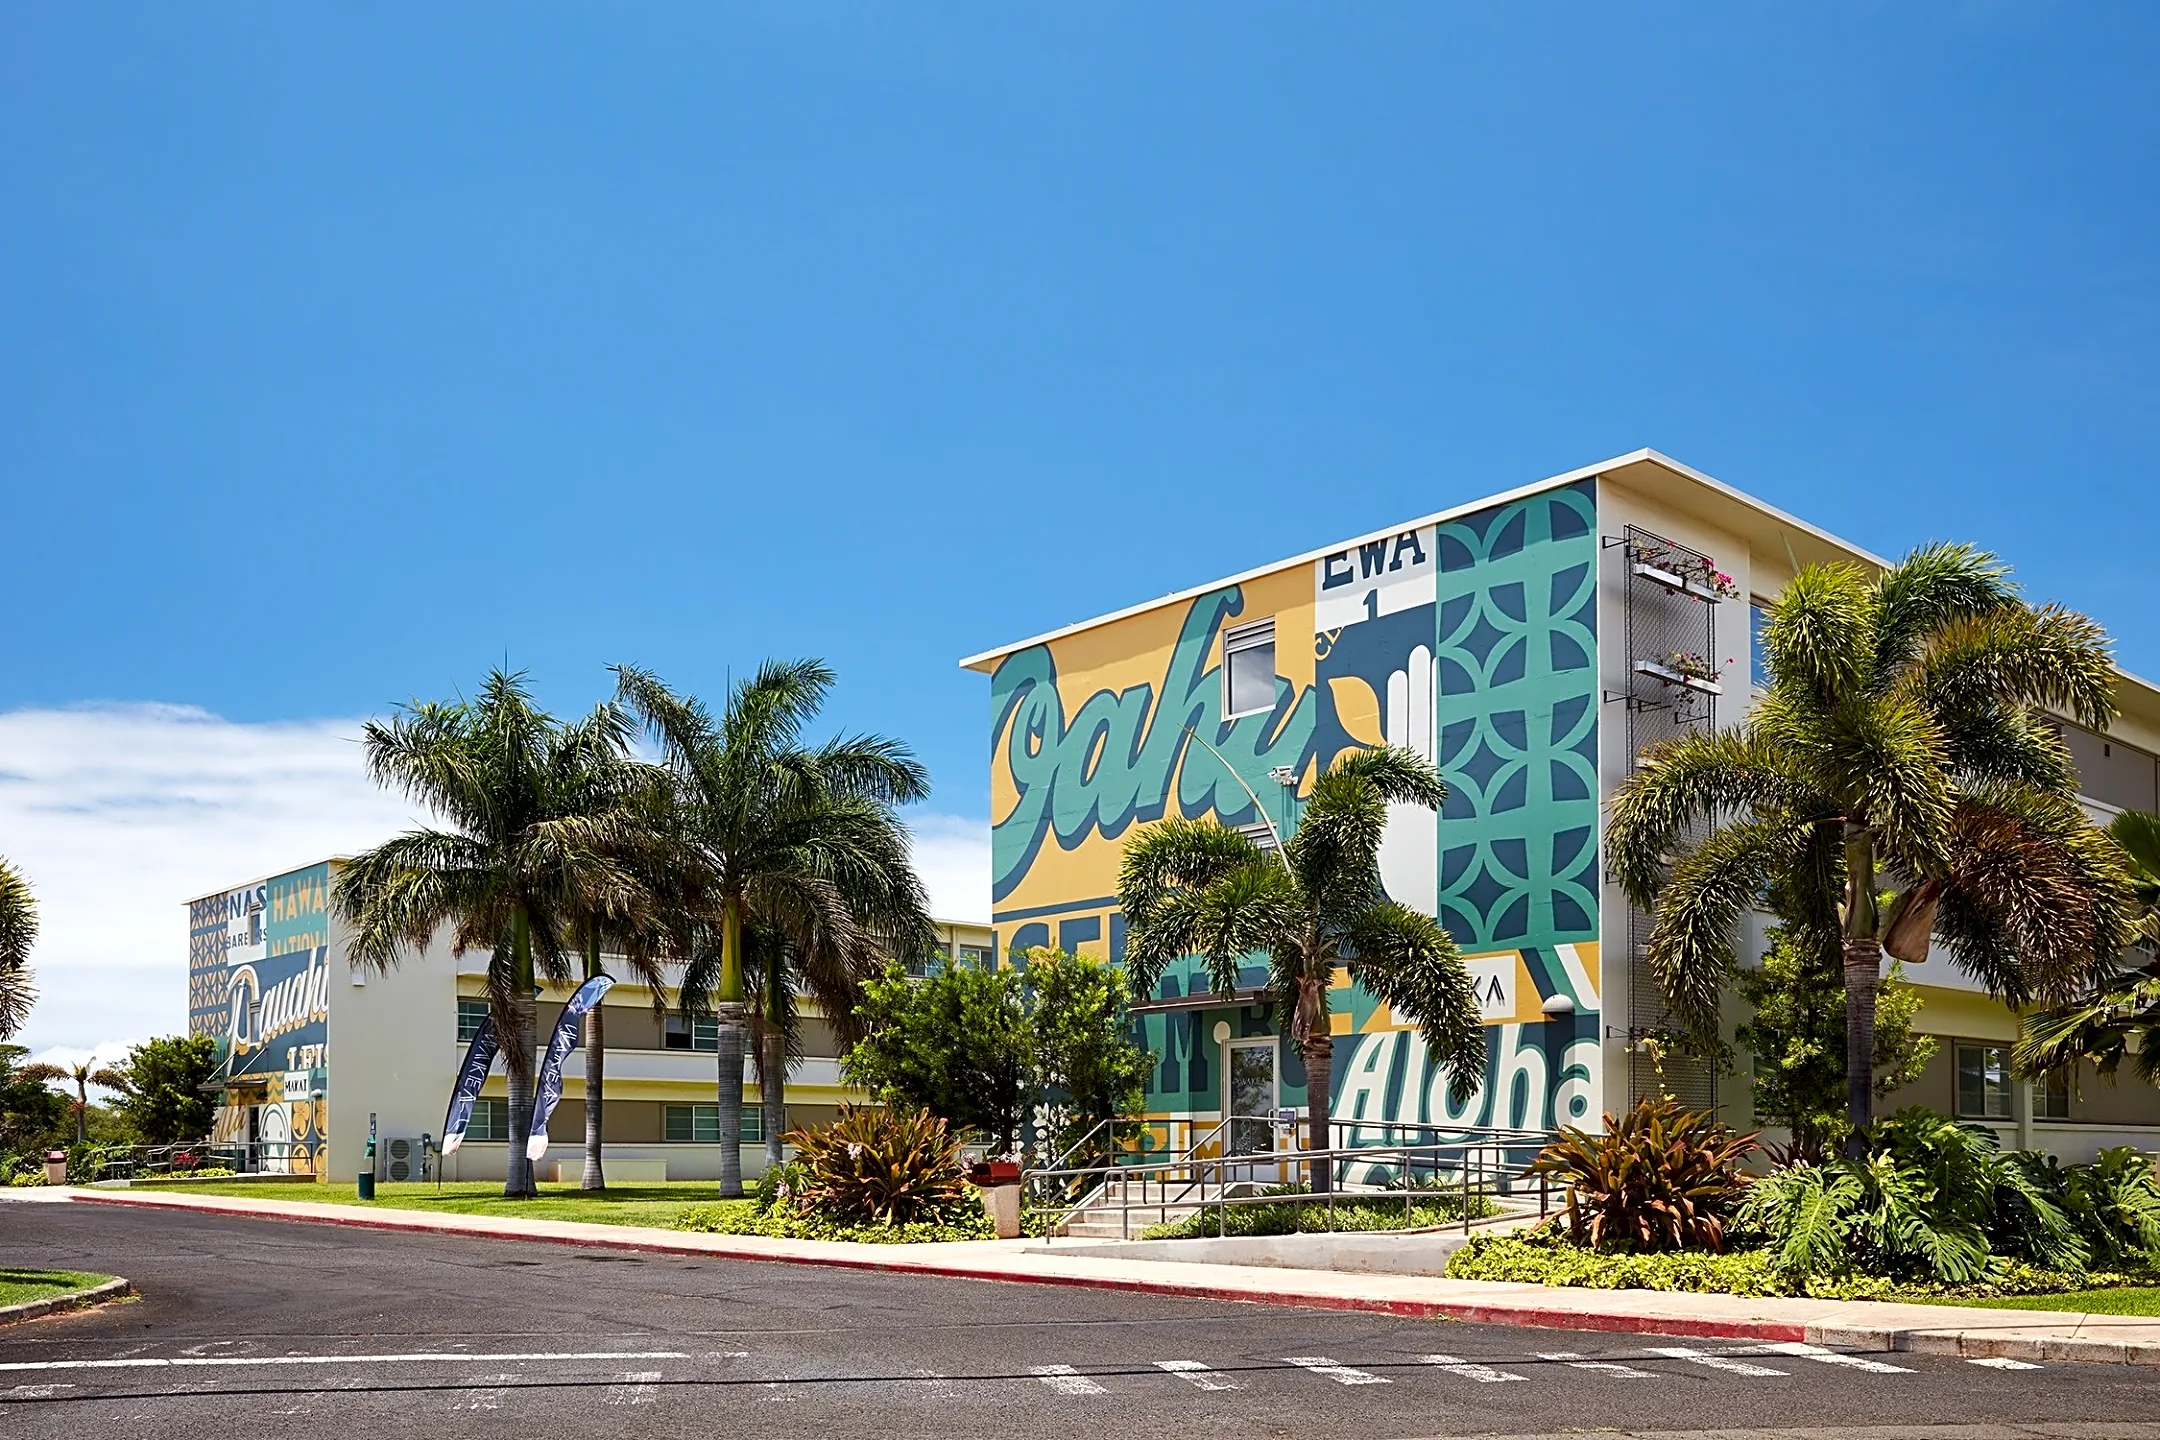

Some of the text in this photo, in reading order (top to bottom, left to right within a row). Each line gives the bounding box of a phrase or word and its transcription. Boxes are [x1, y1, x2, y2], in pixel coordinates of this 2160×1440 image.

[1322, 530, 1426, 591] EWA
[1362, 588, 1378, 620] 1
[991, 584, 1317, 900] Oahu
[229, 885, 267, 920] NAS
[284, 1078, 308, 1094] MAKAI
[1329, 1024, 1602, 1146] Aloha
